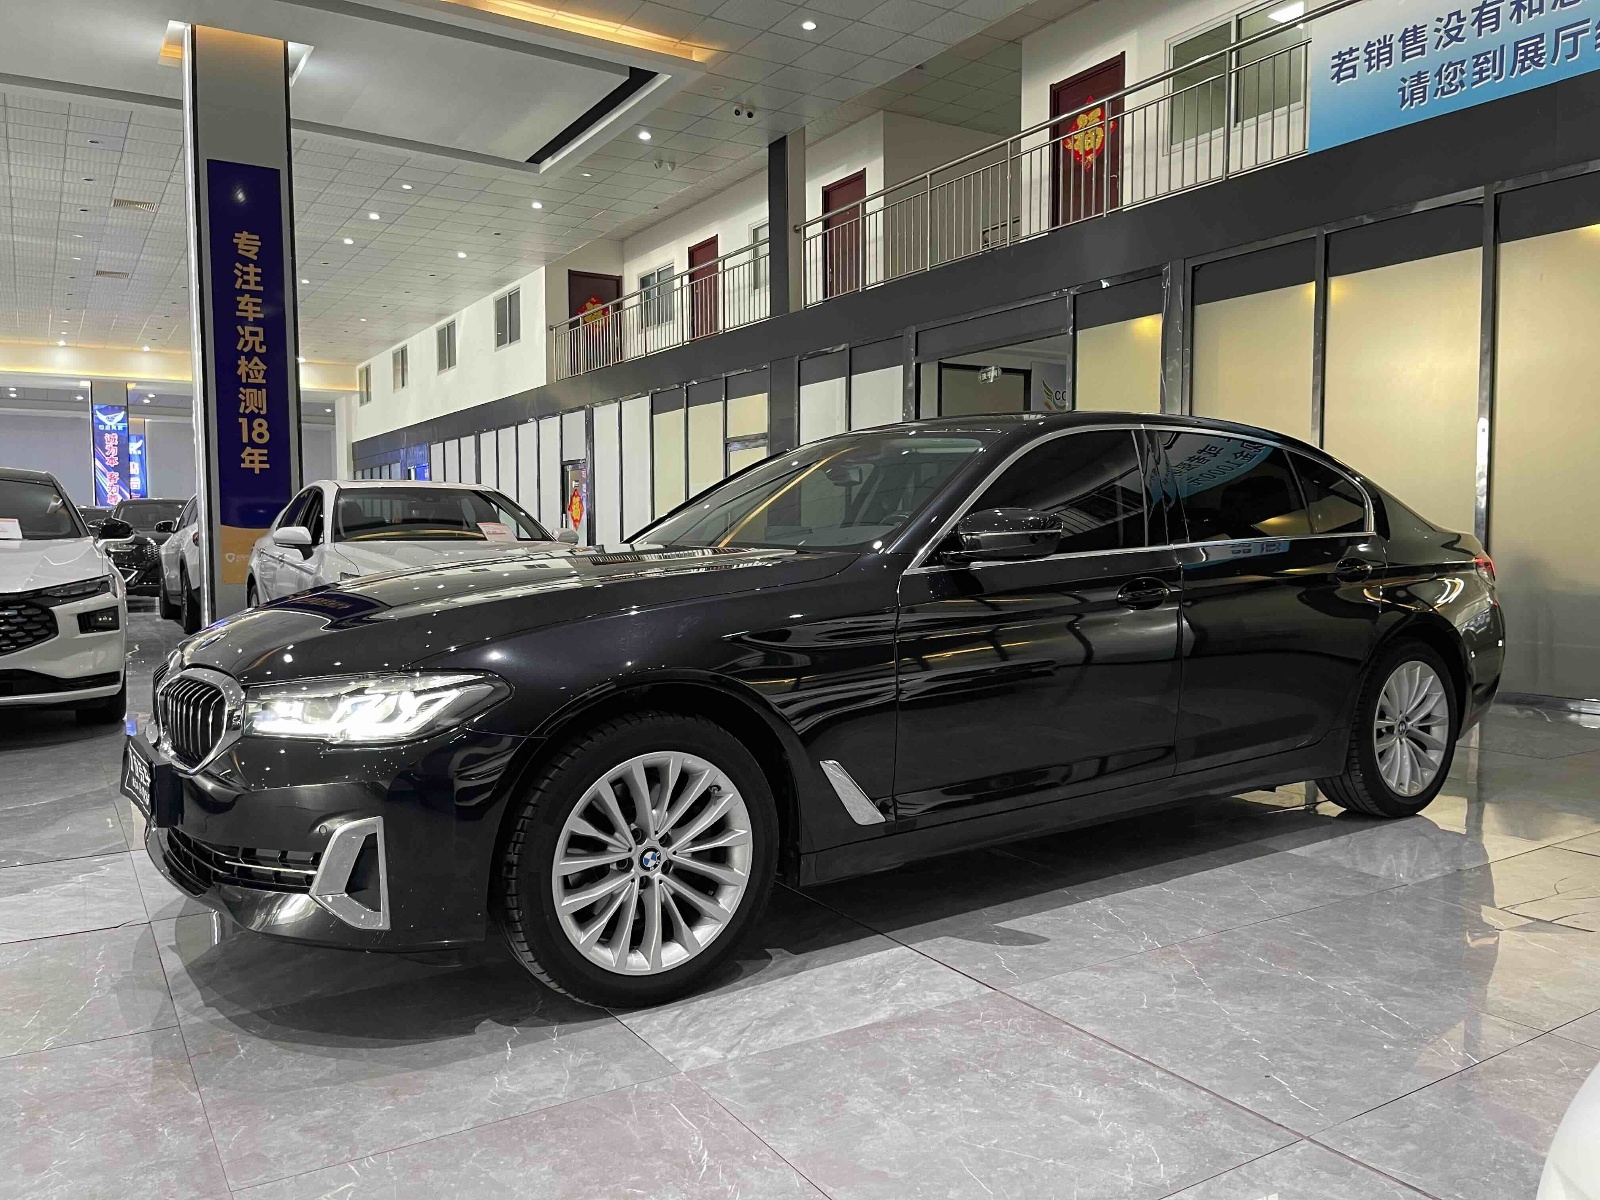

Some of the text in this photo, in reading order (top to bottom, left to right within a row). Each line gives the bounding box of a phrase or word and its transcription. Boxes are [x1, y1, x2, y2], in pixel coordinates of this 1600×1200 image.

[1397, 18, 1600, 110] 请您到展厅
[232, 230, 272, 475] 专注车况检测18年
